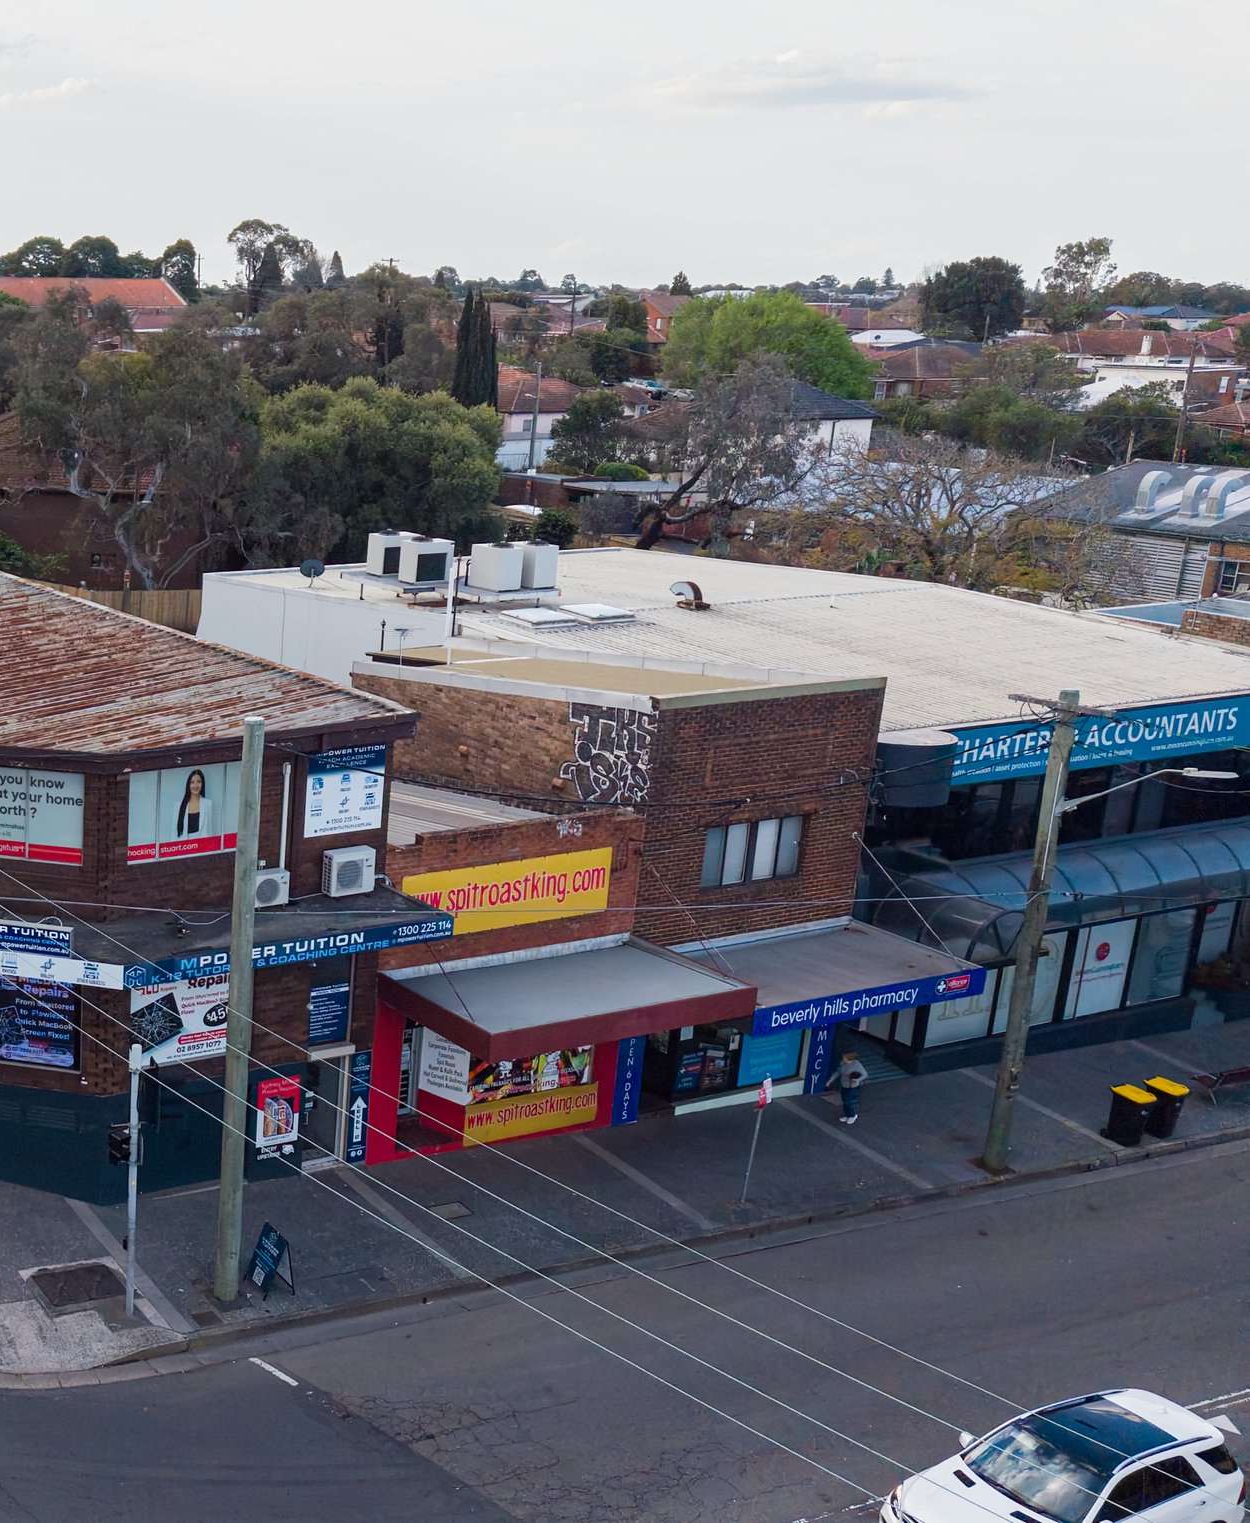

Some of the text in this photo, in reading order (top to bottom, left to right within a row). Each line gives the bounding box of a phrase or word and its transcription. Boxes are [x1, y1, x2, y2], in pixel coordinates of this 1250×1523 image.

[1082, 707, 1238, 748] ACCOUNTANTS
[317, 744, 386, 757] POWER TUITION
[342, 753, 376, 762] ACADEMIC
[995, 764, 1010, 772] asset
[1011, 759, 1041, 771] protection
[0, 774, 22, 786] you
[30, 776, 65, 790] know
[11, 790, 42, 803] your
[46, 793, 83, 807] home
[30, 807, 37, 819] ?
[445, 867, 607, 919] spitroastking.com
[12, 926, 70, 941] TUITION
[398, 920, 451, 938] 1300 225 114
[5, 935, 42, 944] COACHING
[42, 939, 70, 947] CENTRE
[396, 930, 452, 945] mpowertuition.com.au
[2, 941, 71, 956] mpowertuition.com.au
[180, 931, 365, 971] MPOER TUITION
[151, 971, 182, 984] K-12
[257, 957, 267, 966] &
[268, 947, 337, 965] COACHING
[339, 940, 390, 955] CENTRE
[188, 973, 230, 990] Repai
[23, 984, 70, 998] Repairs
[196, 992, 218, 1000] Shattered
[15, 997, 74, 1011] From Shattered
[771, 1003, 820, 1028] beverly
[823, 998, 849, 1018] hills
[852, 987, 919, 1015] pharmacy
[14, 1017, 73, 1031] Quick MacBook
[20, 1028, 70, 1040] Screen Fixes!
[187, 1043, 204, 1052] 8957
[205, 1040, 222, 1048] 1077
[453, 1069, 463, 1077] Pack
[621, 1038, 636, 1121] PEN 6 DAYS
[426, 1078, 445, 1090] Packages
[491, 1078, 512, 1087] PACKAGES
[466, 1092, 596, 1130] www. spitroastking.com
